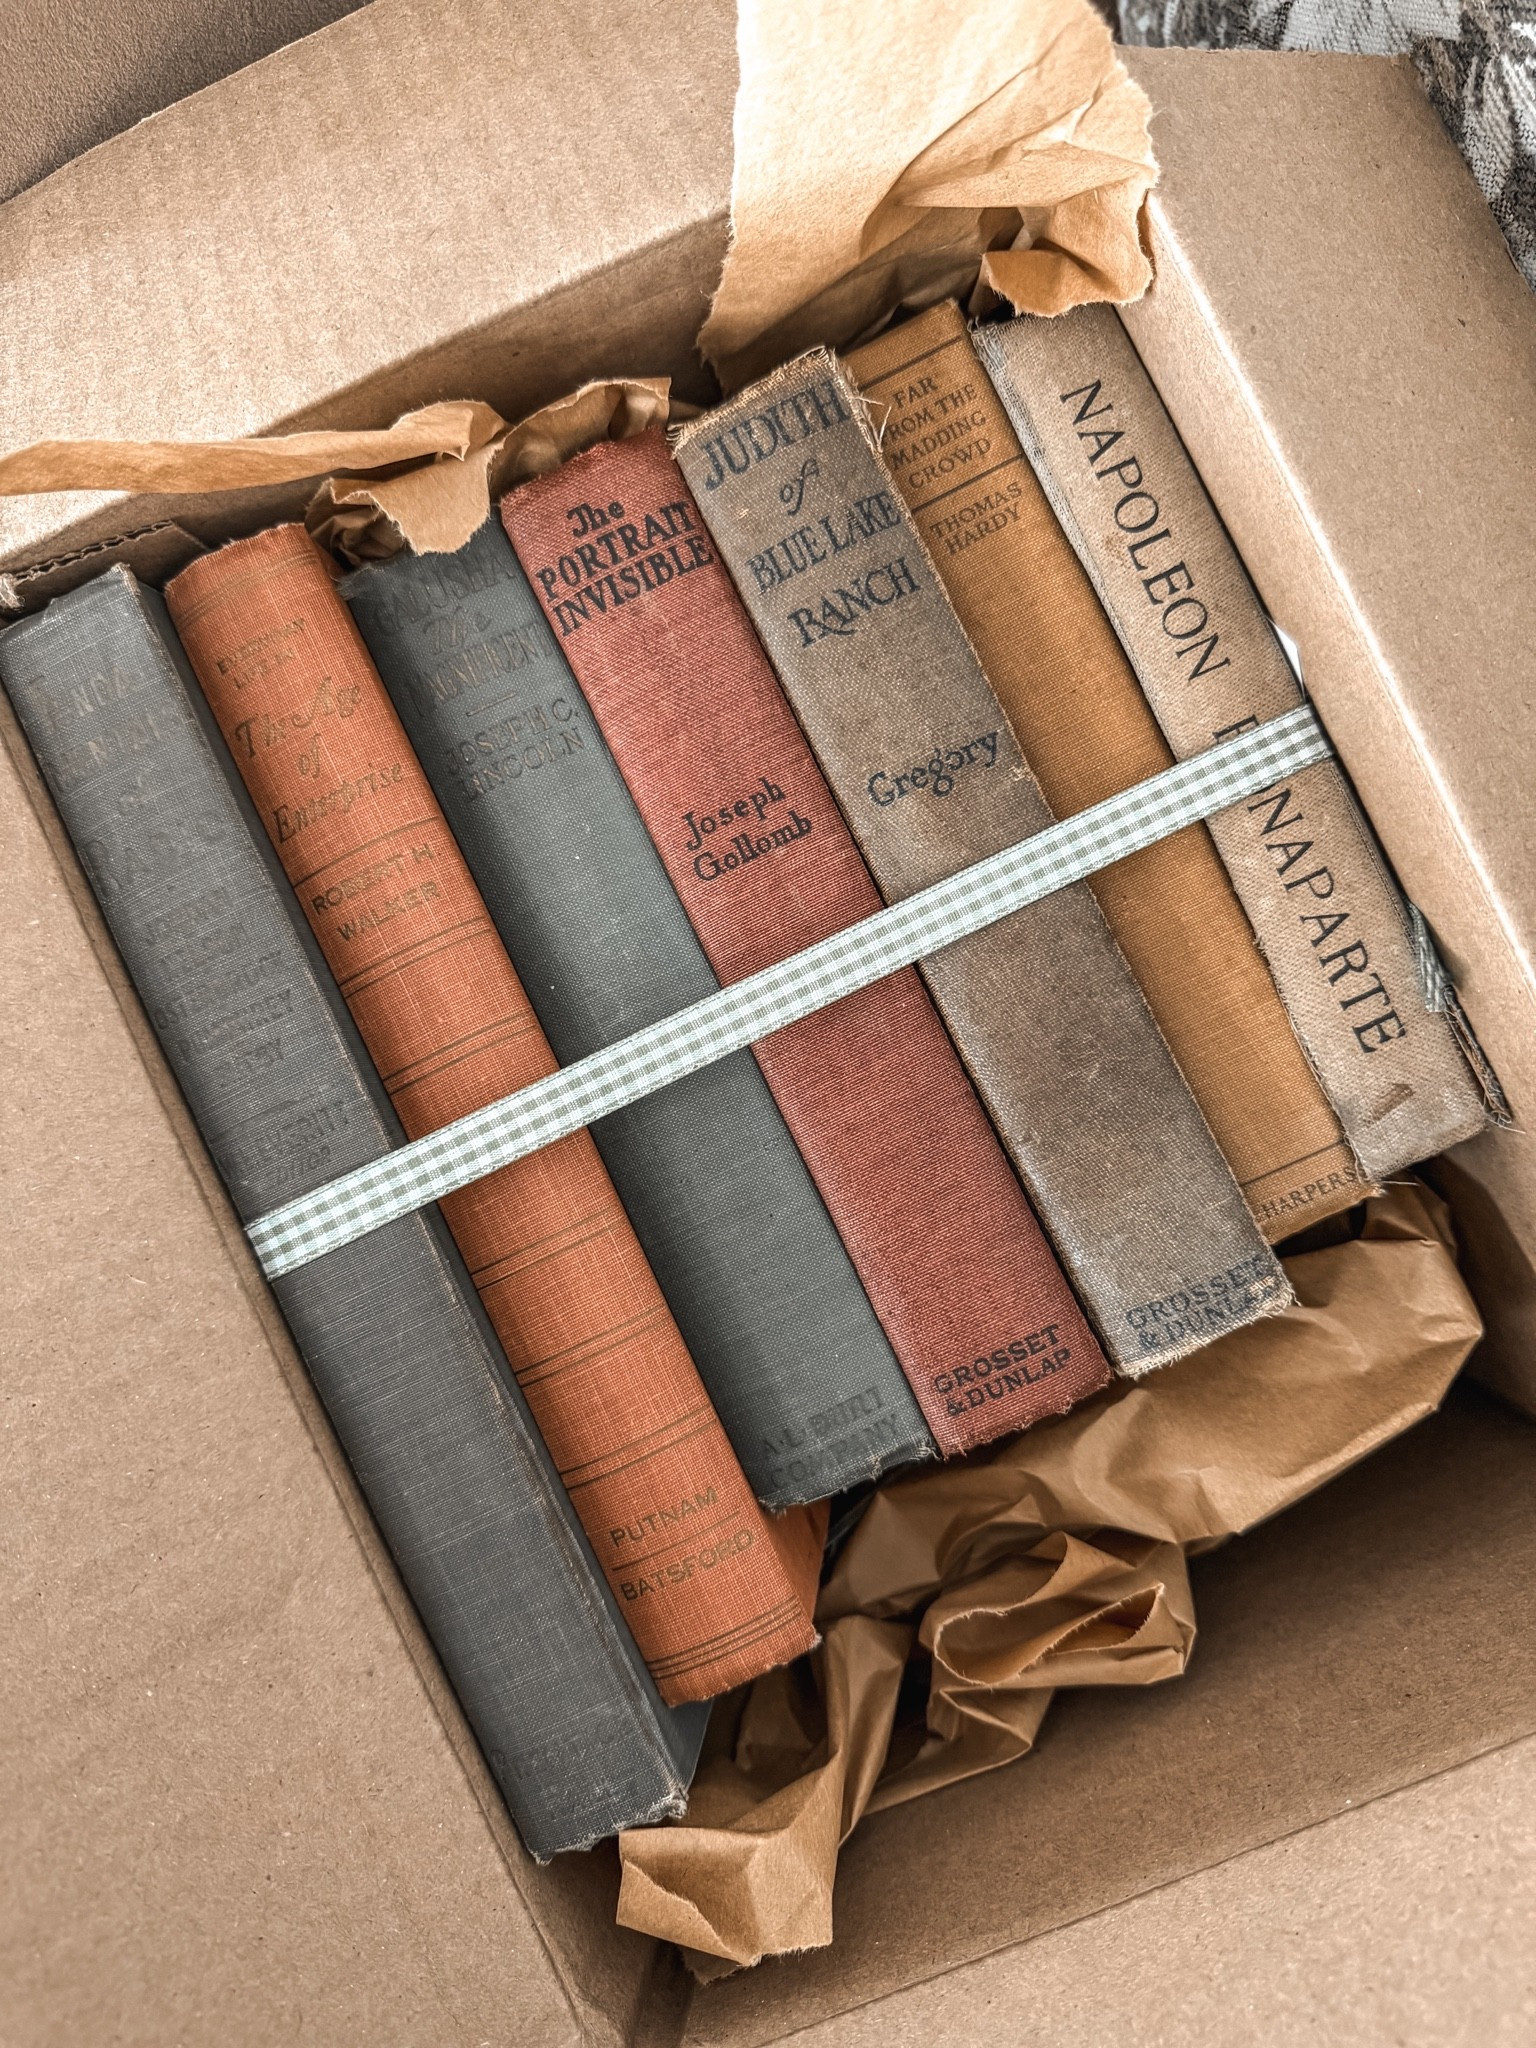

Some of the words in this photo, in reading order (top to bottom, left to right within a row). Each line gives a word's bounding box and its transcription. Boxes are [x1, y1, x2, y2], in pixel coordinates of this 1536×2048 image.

[892, 376, 939, 408] FAR
[934, 383, 978, 414] THE
[698, 381, 852, 489] JUDITH
[890, 410, 987, 470] MADDING
[907, 437, 992, 490] CROWD
[567, 498, 624, 537] The
[777, 458, 822, 516] of
[928, 482, 1023, 540] THOMAS
[535, 500, 697, 601] PORTRAIT
[744, 526, 828, 595] BLUE
[820, 491, 902, 554] LAKE
[945, 503, 1023, 556] HARDY
[1060, 378, 1230, 682] NAPOLEON
[551, 537, 715, 635] INVISIBLE
[787, 556, 922, 649] RANCH
[234, 709, 292, 759] The
[296, 732, 325, 780] of
[444, 707, 552, 775] JOSEPH
[460, 726, 586, 801] LINCOLN
[271, 759, 404, 842] Enterprise
[865, 729, 1003, 810] Gregory
[681, 776, 787, 849] Joseph
[692, 813, 814, 882] Gollomb
[310, 853, 407, 914] ROBERT
[336, 881, 442, 941] WALKER
[1262, 1164, 1359, 1219] HARPERS
[1126, 1252, 1269, 1329] GROSSET
[933, 1324, 1063, 1393] GROSSET
[612, 1485, 719, 1549] PUTNAM
[621, 1528, 755, 1604] BATSFORD
